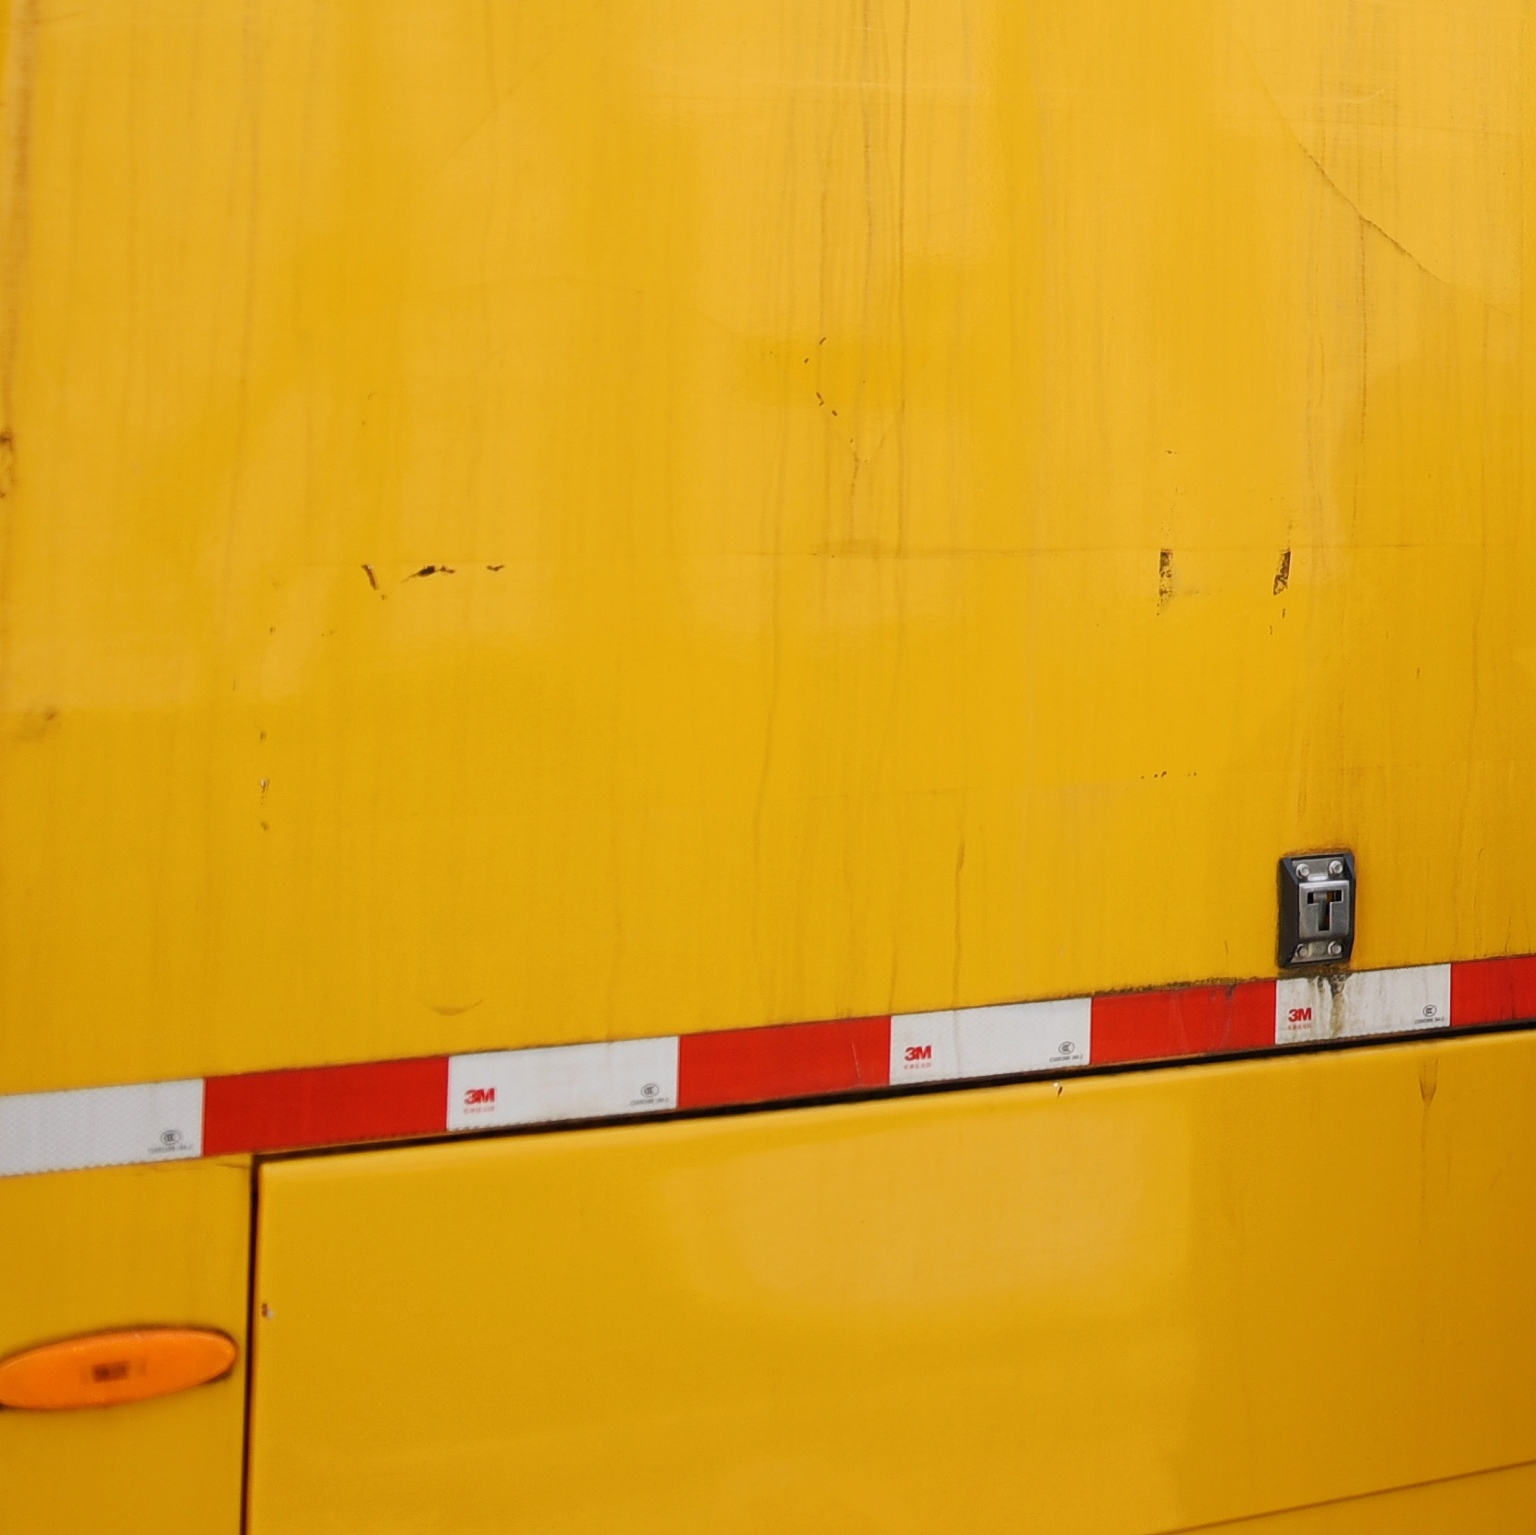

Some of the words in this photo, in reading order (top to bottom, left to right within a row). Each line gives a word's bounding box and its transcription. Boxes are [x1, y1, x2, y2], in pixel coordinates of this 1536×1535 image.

[1288, 1006, 1312, 1023] 3M
[904, 1044, 932, 1062] 3M
[464, 1087, 496, 1105] 3M
